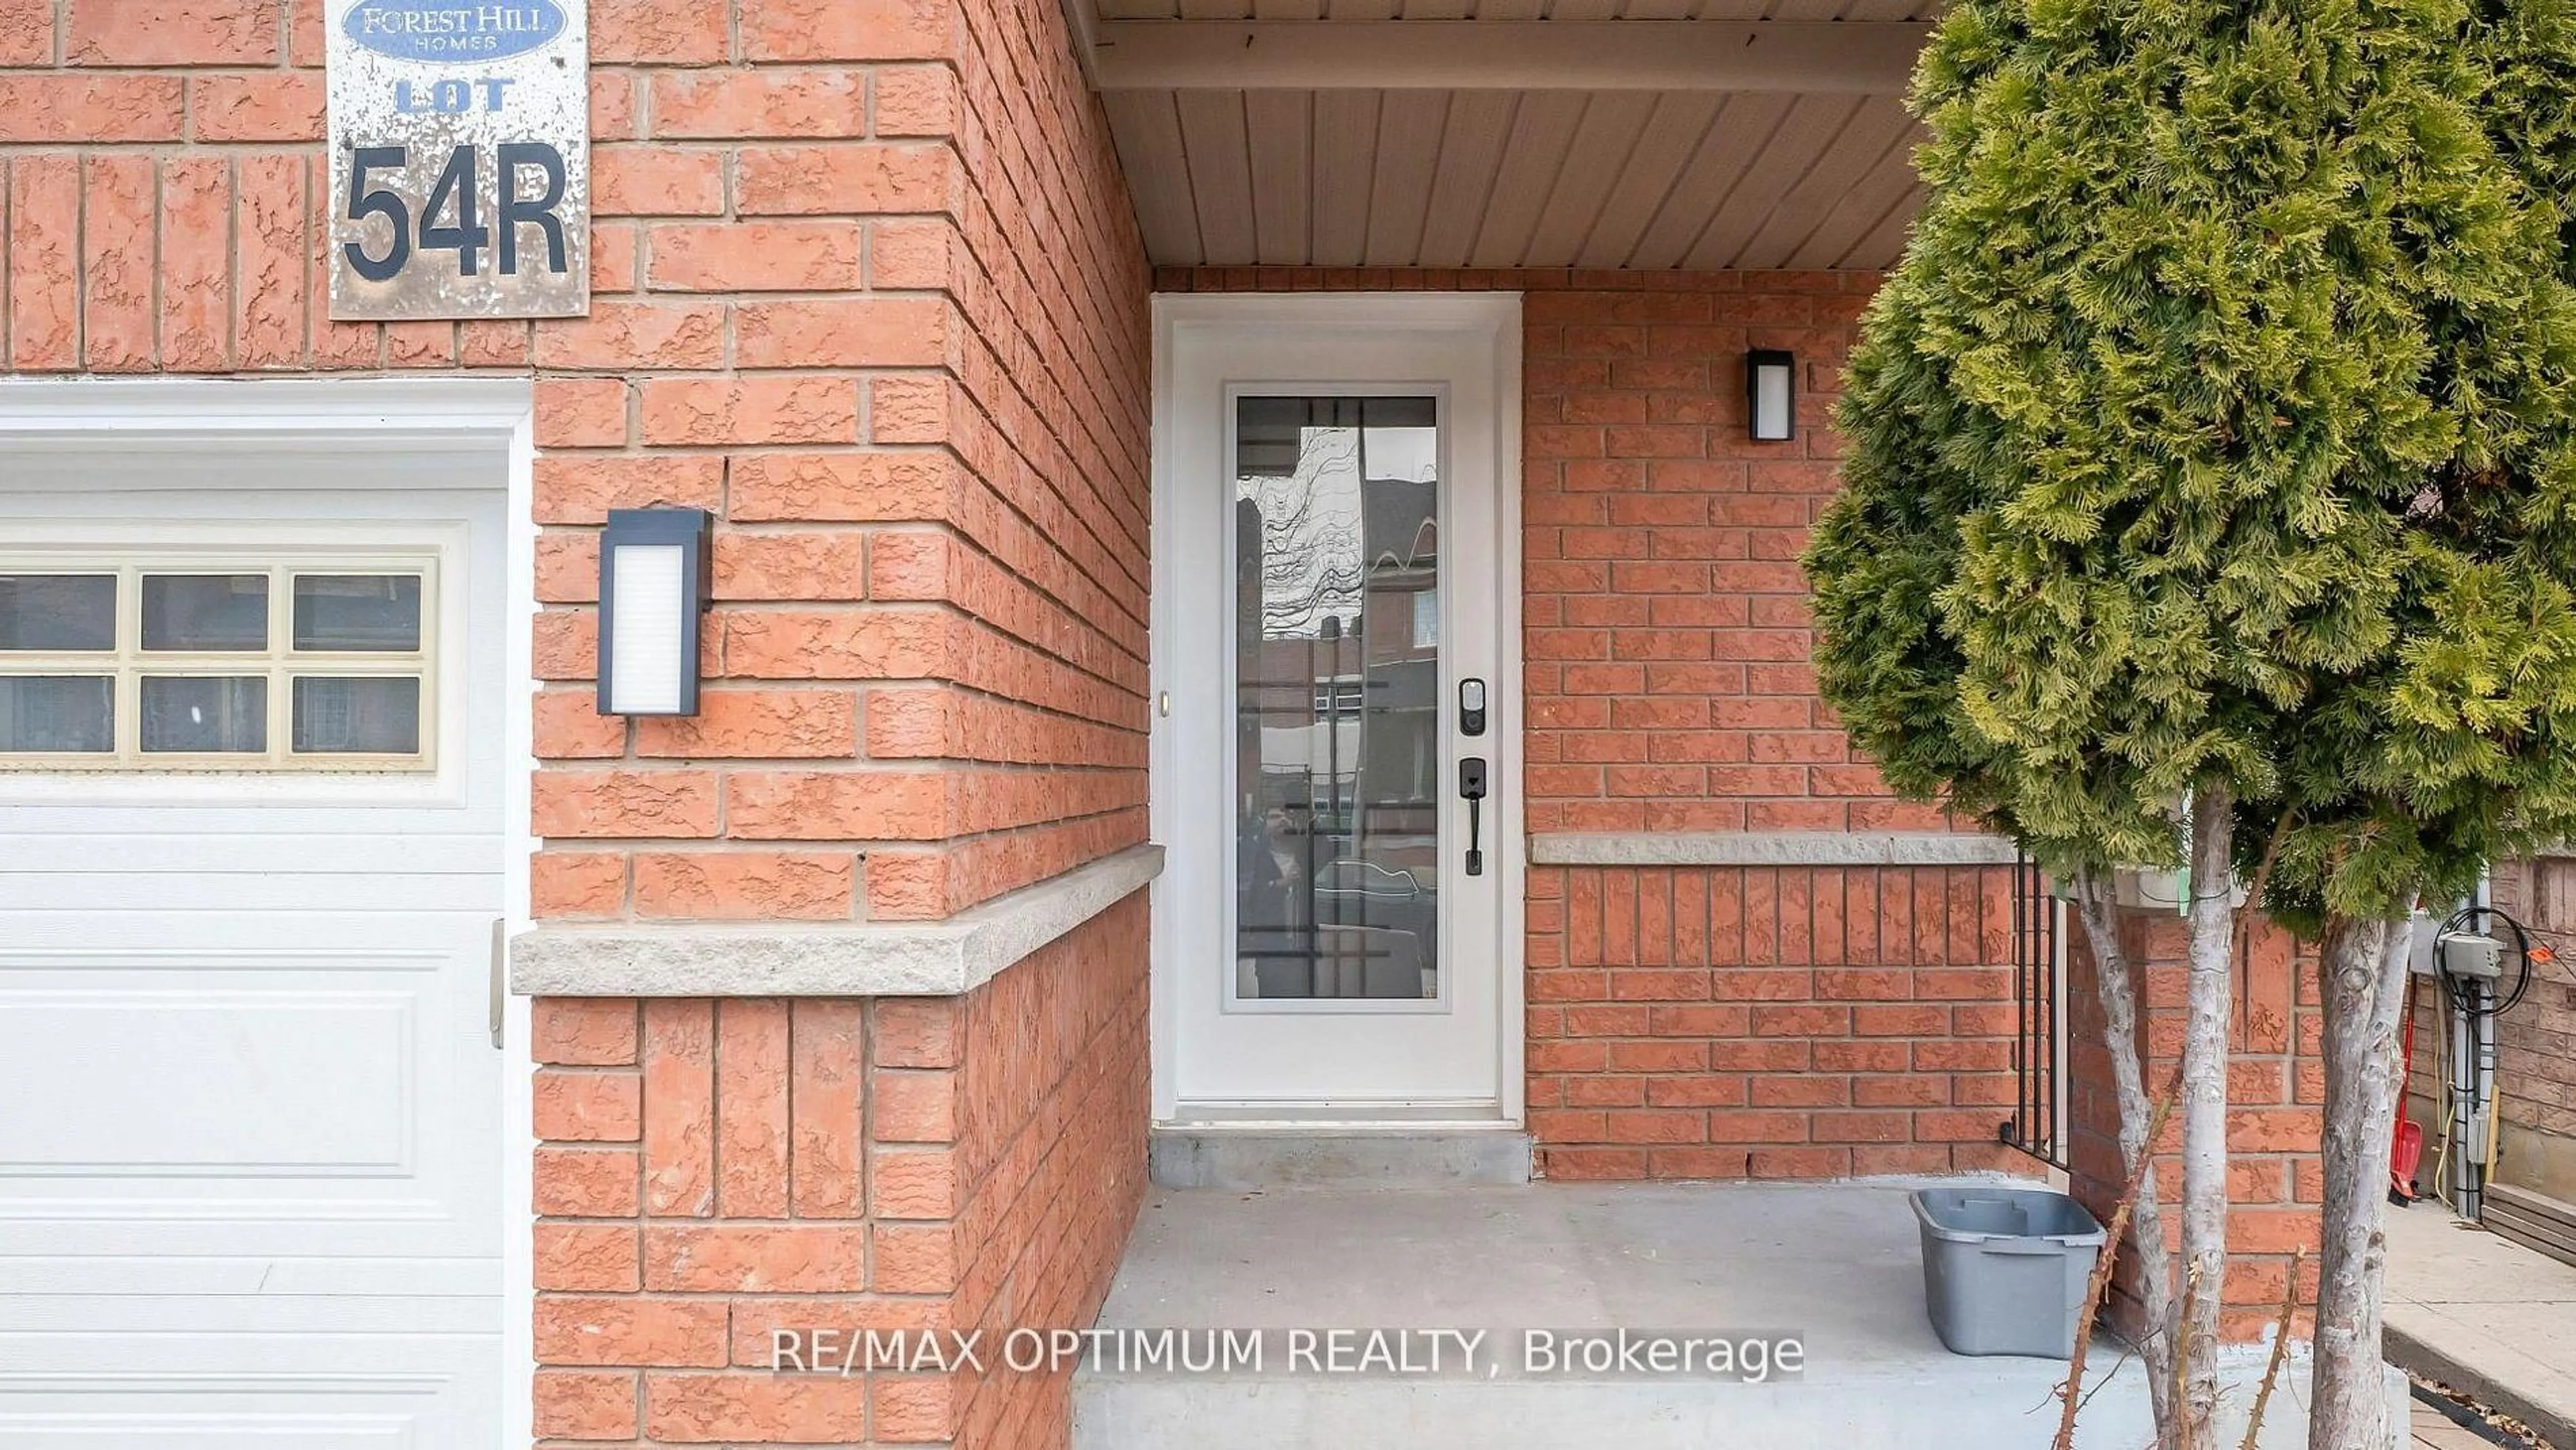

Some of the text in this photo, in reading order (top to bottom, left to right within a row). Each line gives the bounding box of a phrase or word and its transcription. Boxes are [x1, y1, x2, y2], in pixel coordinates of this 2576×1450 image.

[362, 6, 547, 34] FOREST HILL
[415, 36, 498, 52] HOMES
[394, 77, 515, 113] LOT
[344, 142, 568, 282] 54R
